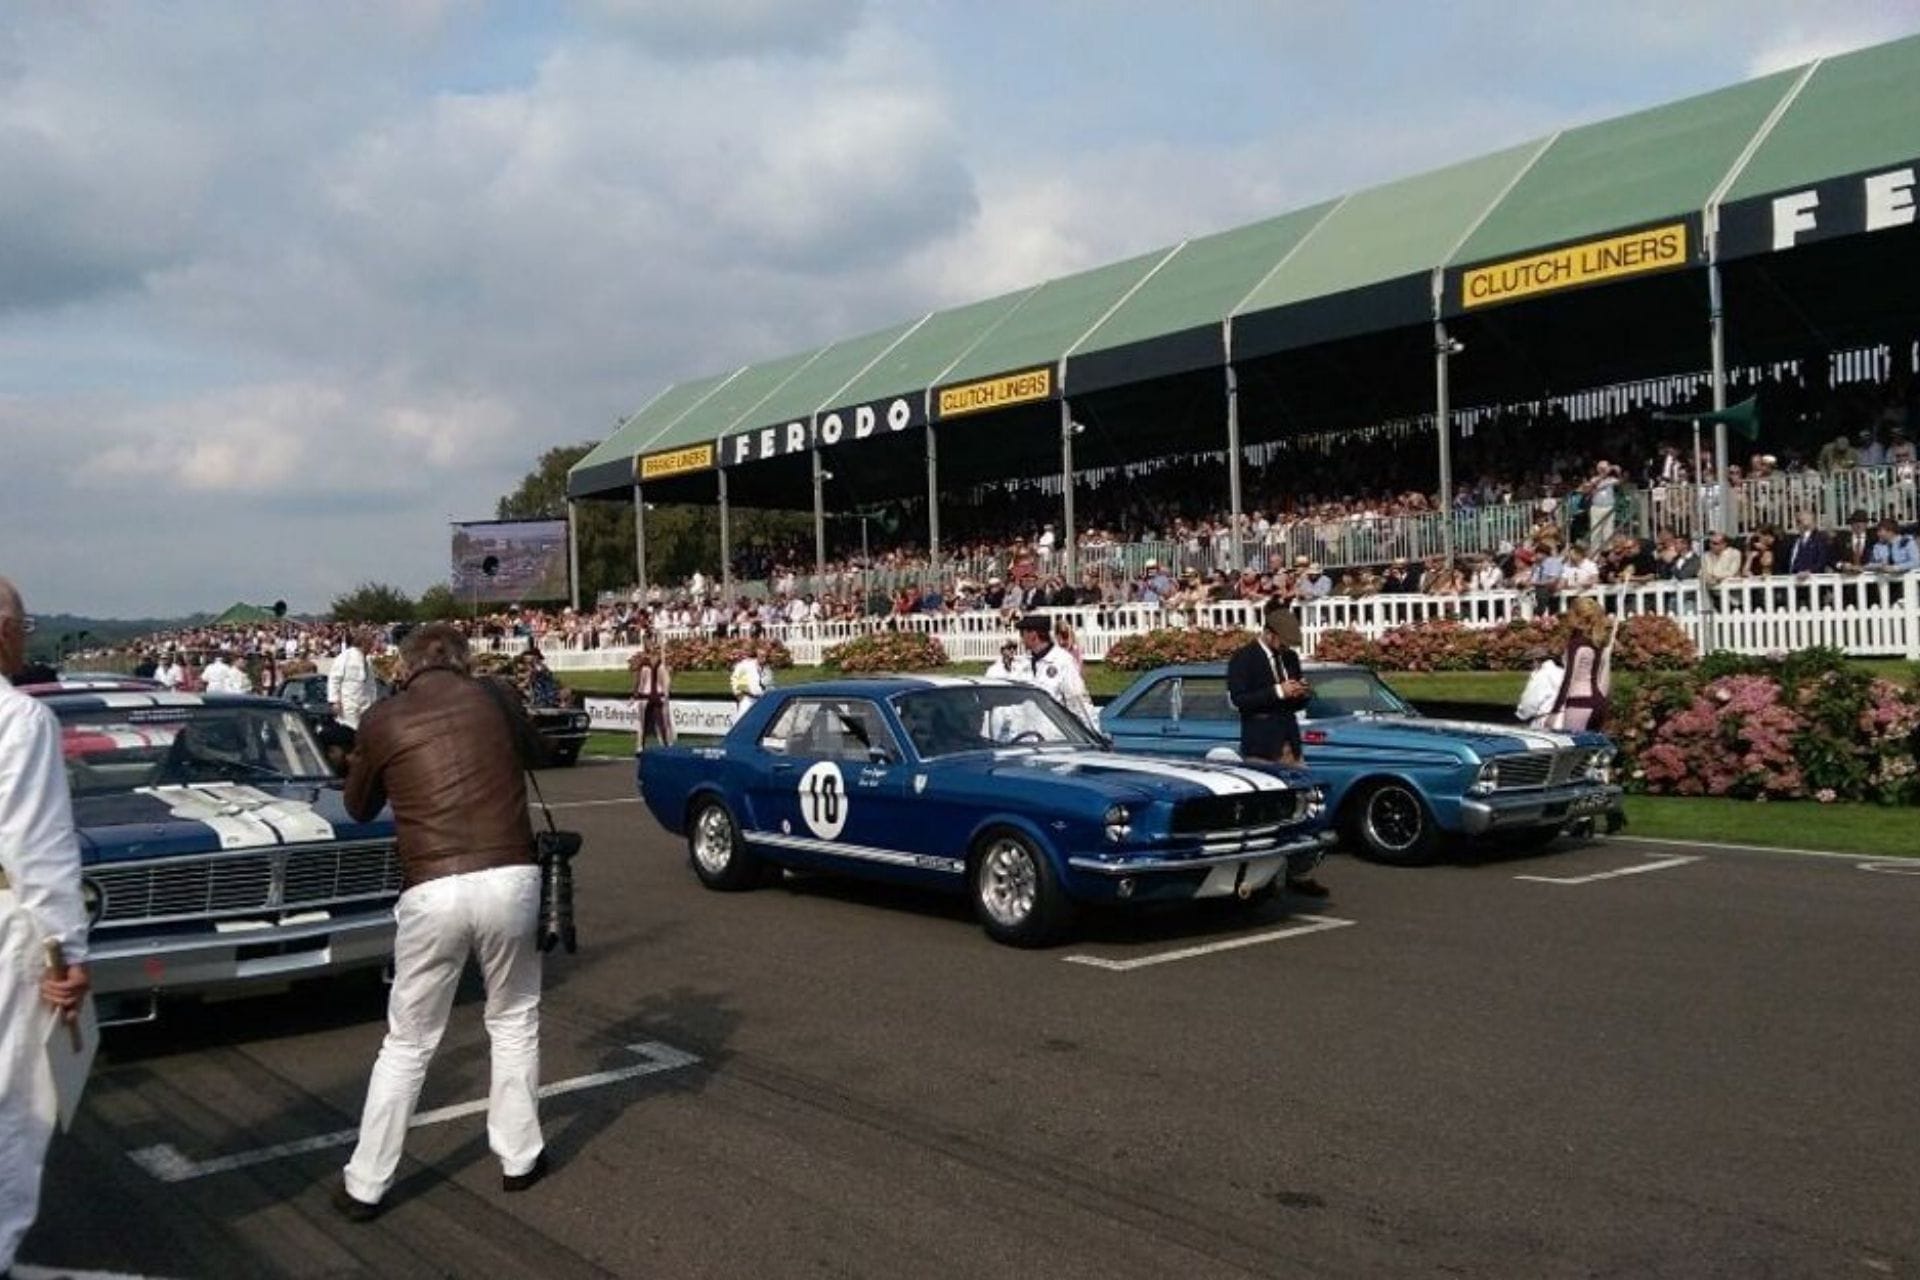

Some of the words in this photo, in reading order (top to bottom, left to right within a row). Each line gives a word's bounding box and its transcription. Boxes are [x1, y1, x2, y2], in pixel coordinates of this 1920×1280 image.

[1772, 168, 1917, 251] FE
[1470, 255, 1572, 298] CLUTCH
[1581, 234, 1678, 274] LINERS
[943, 387, 994, 411] CLUTCH
[999, 374, 1046, 400] LINERS
[734, 398, 911, 464] FERODO
[810, 773, 839, 824] 10
